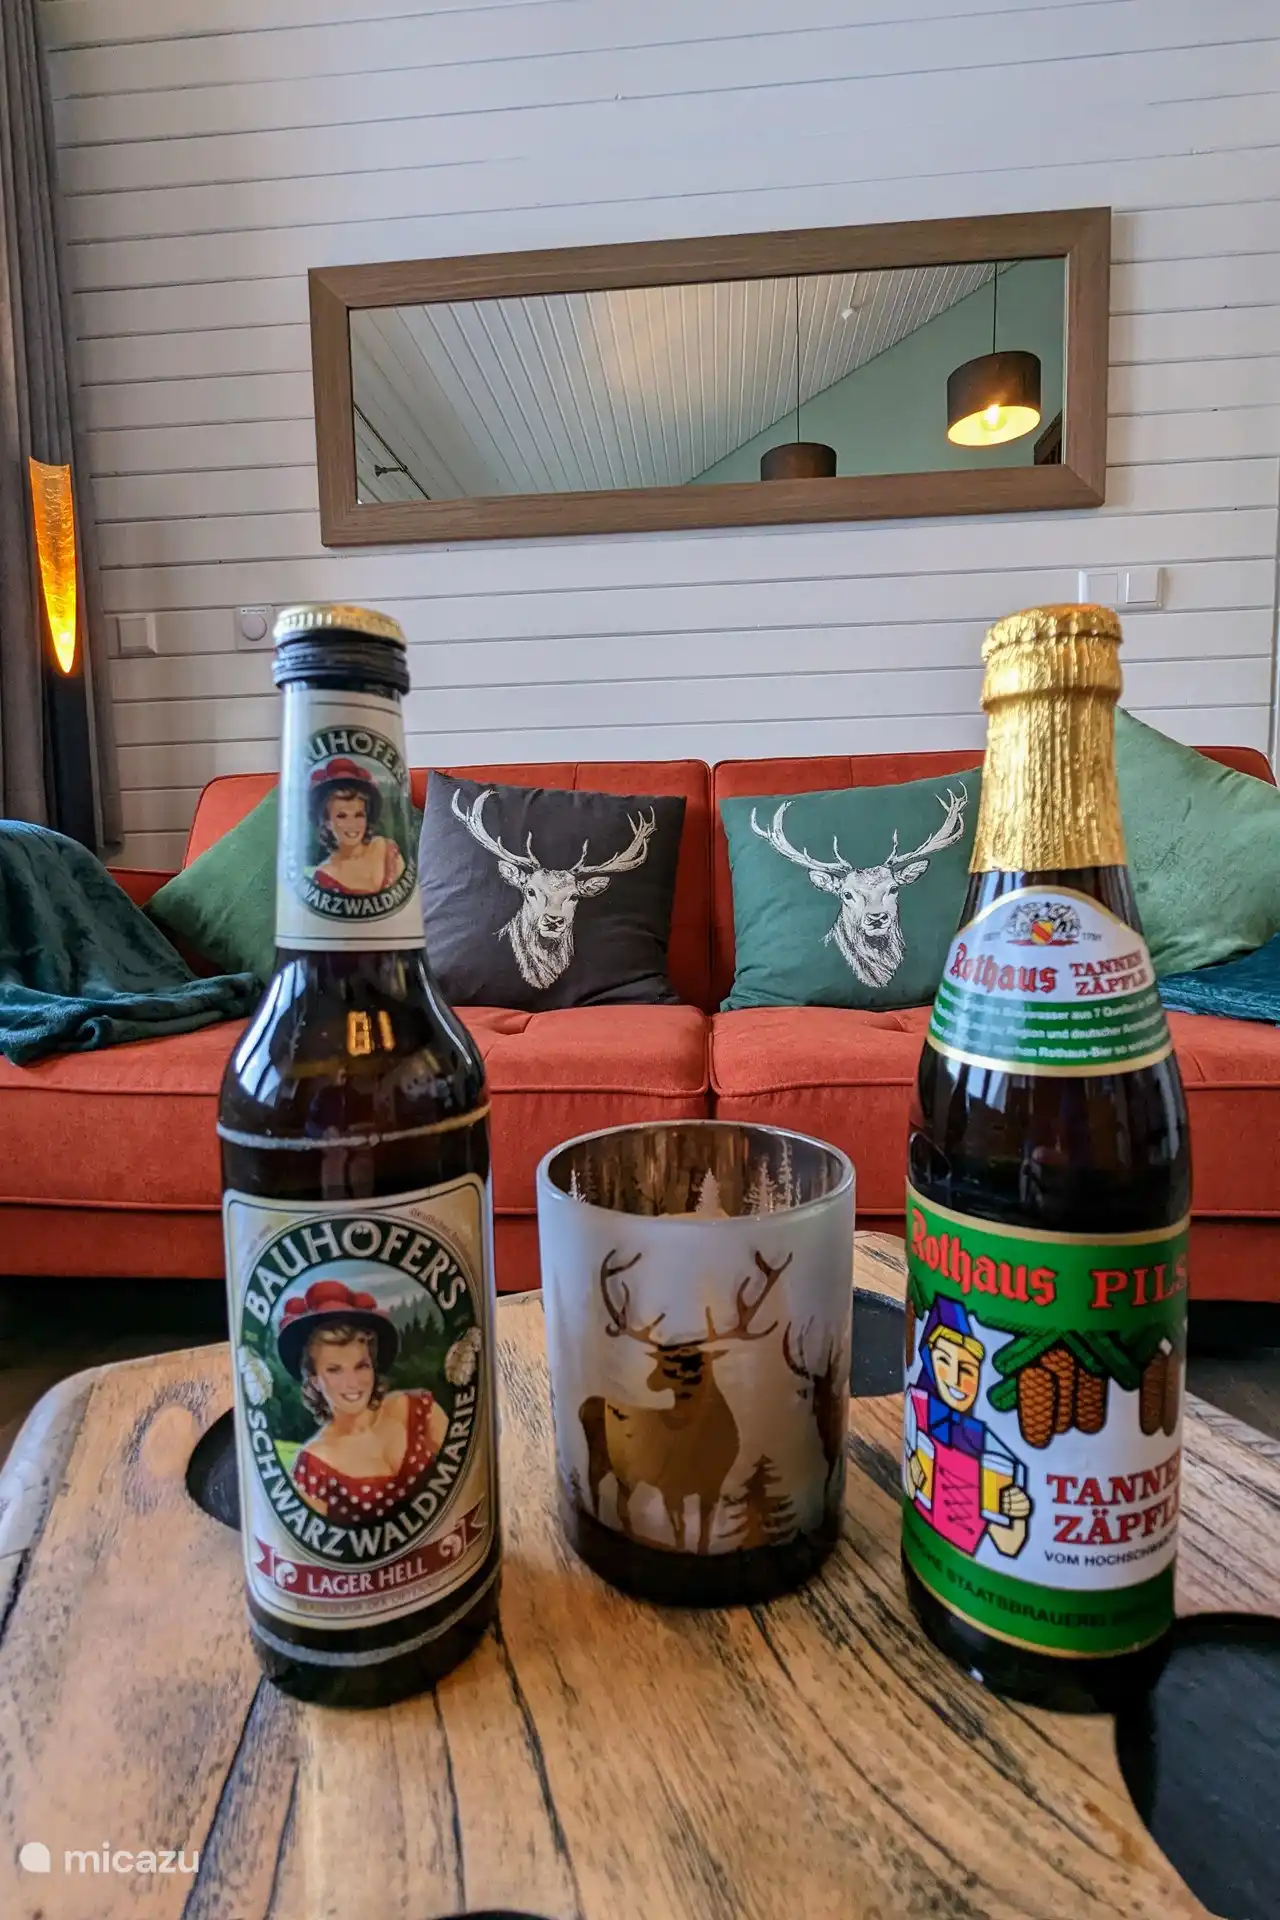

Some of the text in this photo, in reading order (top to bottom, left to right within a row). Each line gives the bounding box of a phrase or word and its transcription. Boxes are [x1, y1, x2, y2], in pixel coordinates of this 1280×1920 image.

[949, 943, 1057, 993] Rothaus
[911, 1208, 1057, 1306] Rothaus
[247, 1385, 476, 1558] SCHWARZWALDMARIE
[307, 1557, 428, 1595] LAGER HELL
[1044, 1550, 1080, 1566] VOM
